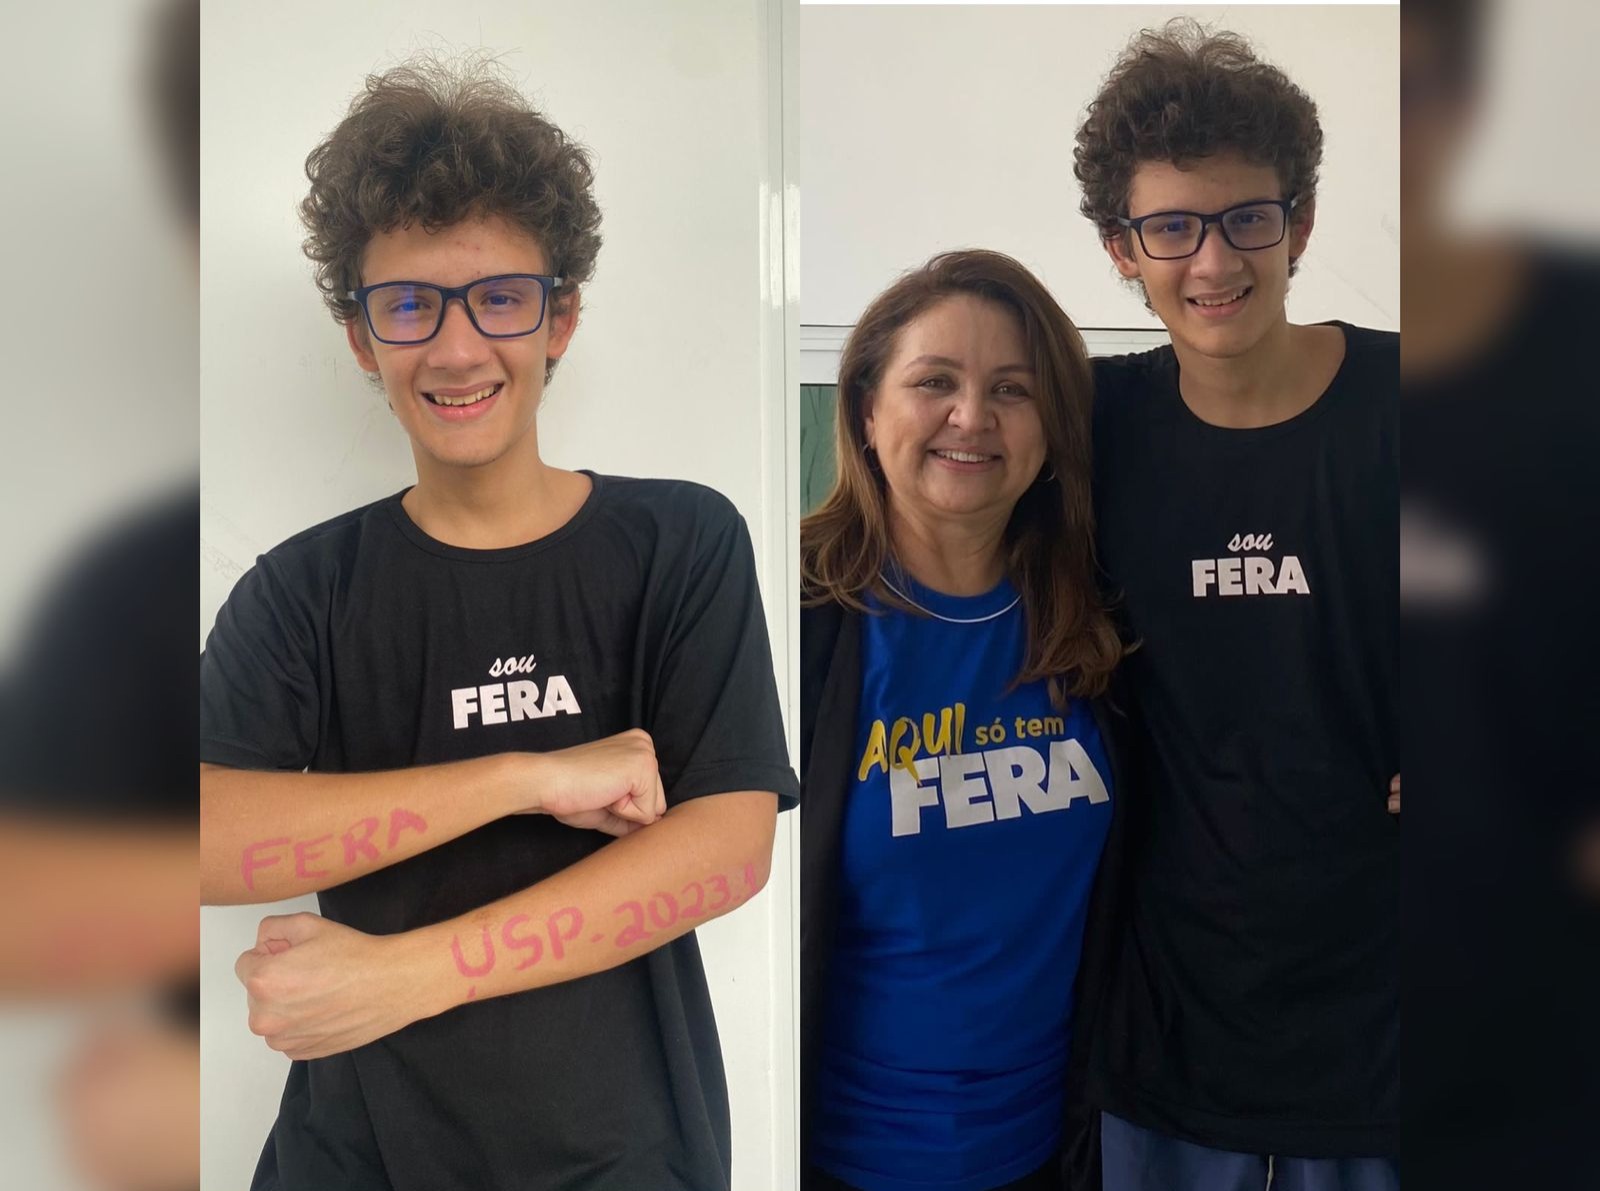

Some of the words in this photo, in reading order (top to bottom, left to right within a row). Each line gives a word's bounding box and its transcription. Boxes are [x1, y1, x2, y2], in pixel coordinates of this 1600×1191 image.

[1228, 530, 1273, 552] sou
[1192, 556, 1310, 597] FERA
[489, 653, 537, 678] sou
[451, 675, 581, 729] FERA
[857, 703, 966, 786] AQUI
[975, 717, 1006, 746] só
[1014, 714, 1064, 740] tem
[889, 738, 1109, 837] FERA
[240, 807, 428, 891] FERA
